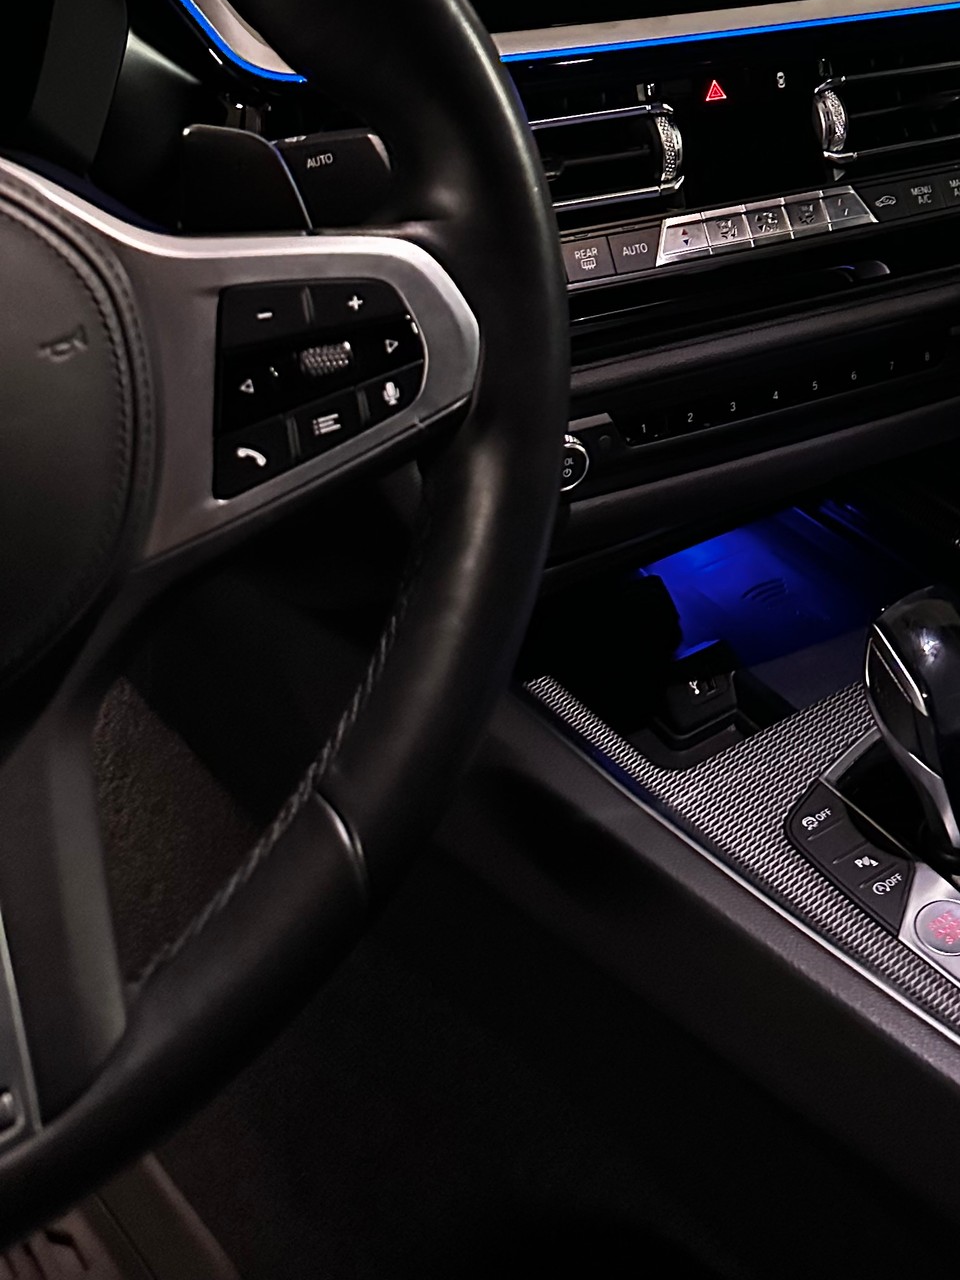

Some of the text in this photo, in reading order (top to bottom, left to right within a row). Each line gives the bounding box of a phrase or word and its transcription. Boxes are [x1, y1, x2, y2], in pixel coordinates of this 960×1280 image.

[306, 152, 334, 169] AUTO
[910, 185, 933, 196] MENU
[917, 194, 933, 205] A/C
[574, 247, 598, 260] REAR
[622, 242, 649, 257] AUTO
[641, 423, 647, 433] 1
[687, 412, 694, 423] 2
[730, 401, 737, 412] 3
[772, 390, 779, 400] 4
[812, 380, 818, 391] 5
[850, 370, 857, 381] 6
[889, 360, 895, 371] 7
[563, 457, 575, 467] OL
[815, 808, 832, 822] OFF
[885, 872, 902, 887] OFF
